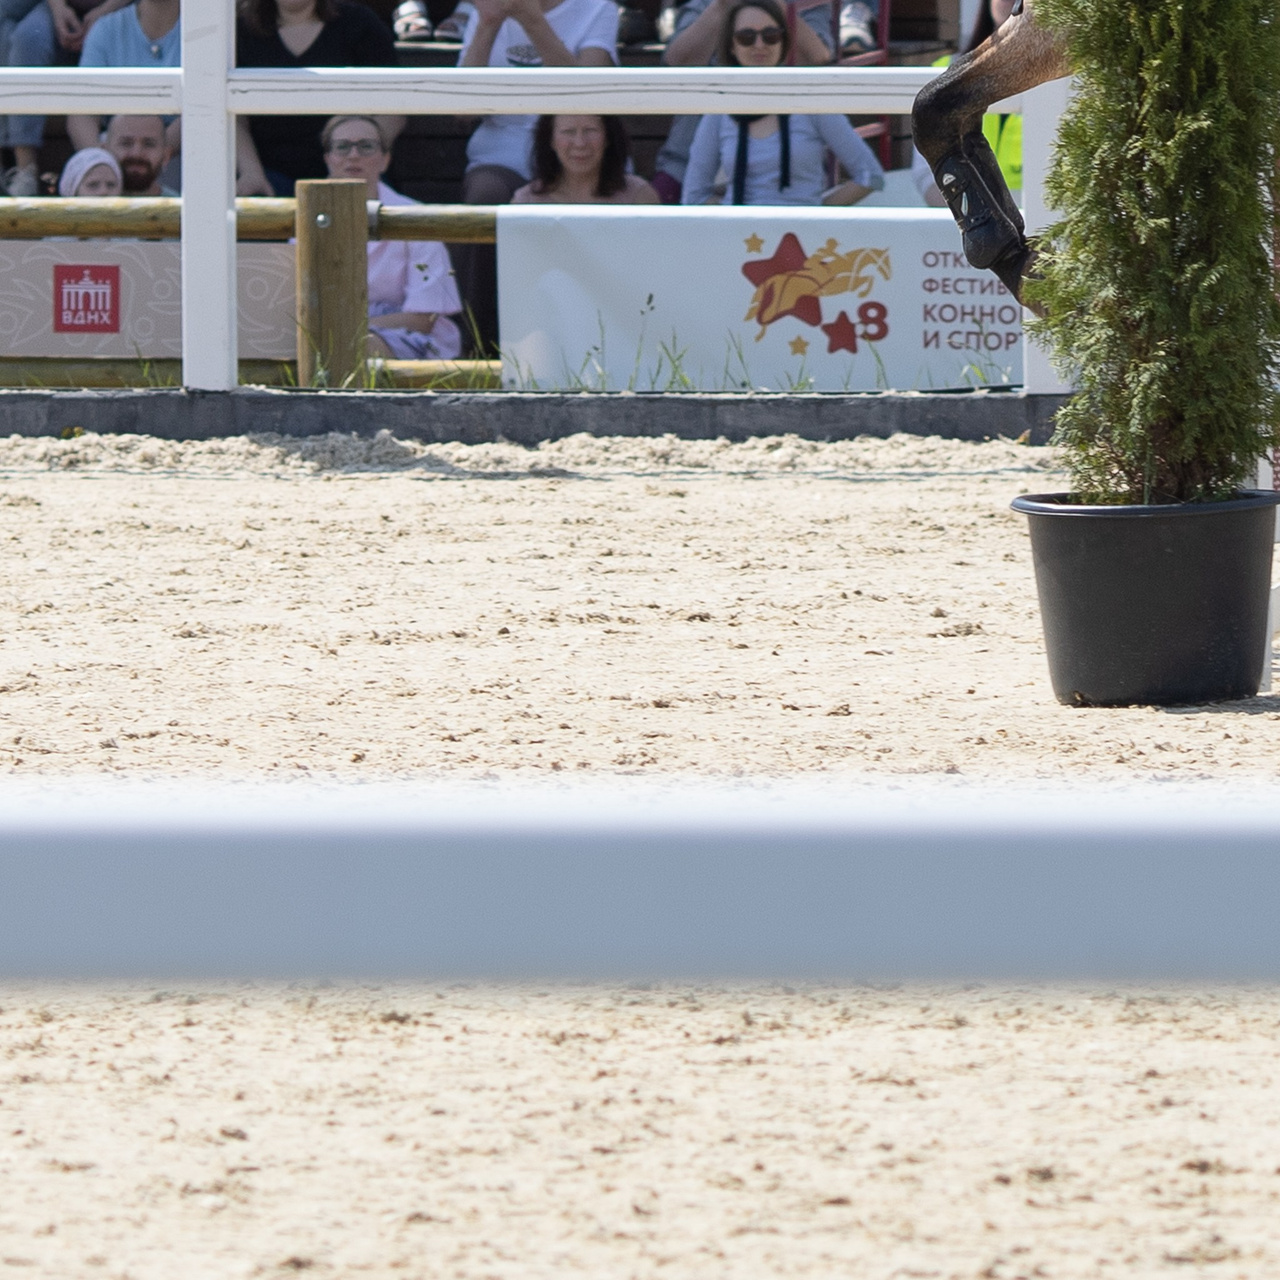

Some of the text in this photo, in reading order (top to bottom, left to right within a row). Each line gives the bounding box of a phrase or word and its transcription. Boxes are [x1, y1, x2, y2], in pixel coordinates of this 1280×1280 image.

[923, 251, 970, 269] ОТК
[922, 278, 1010, 296] ФЕСТИВ
[62, 310, 111, 325] ВДНХ
[922, 303, 1023, 325] КОННО
[923, 330, 940, 349] И
